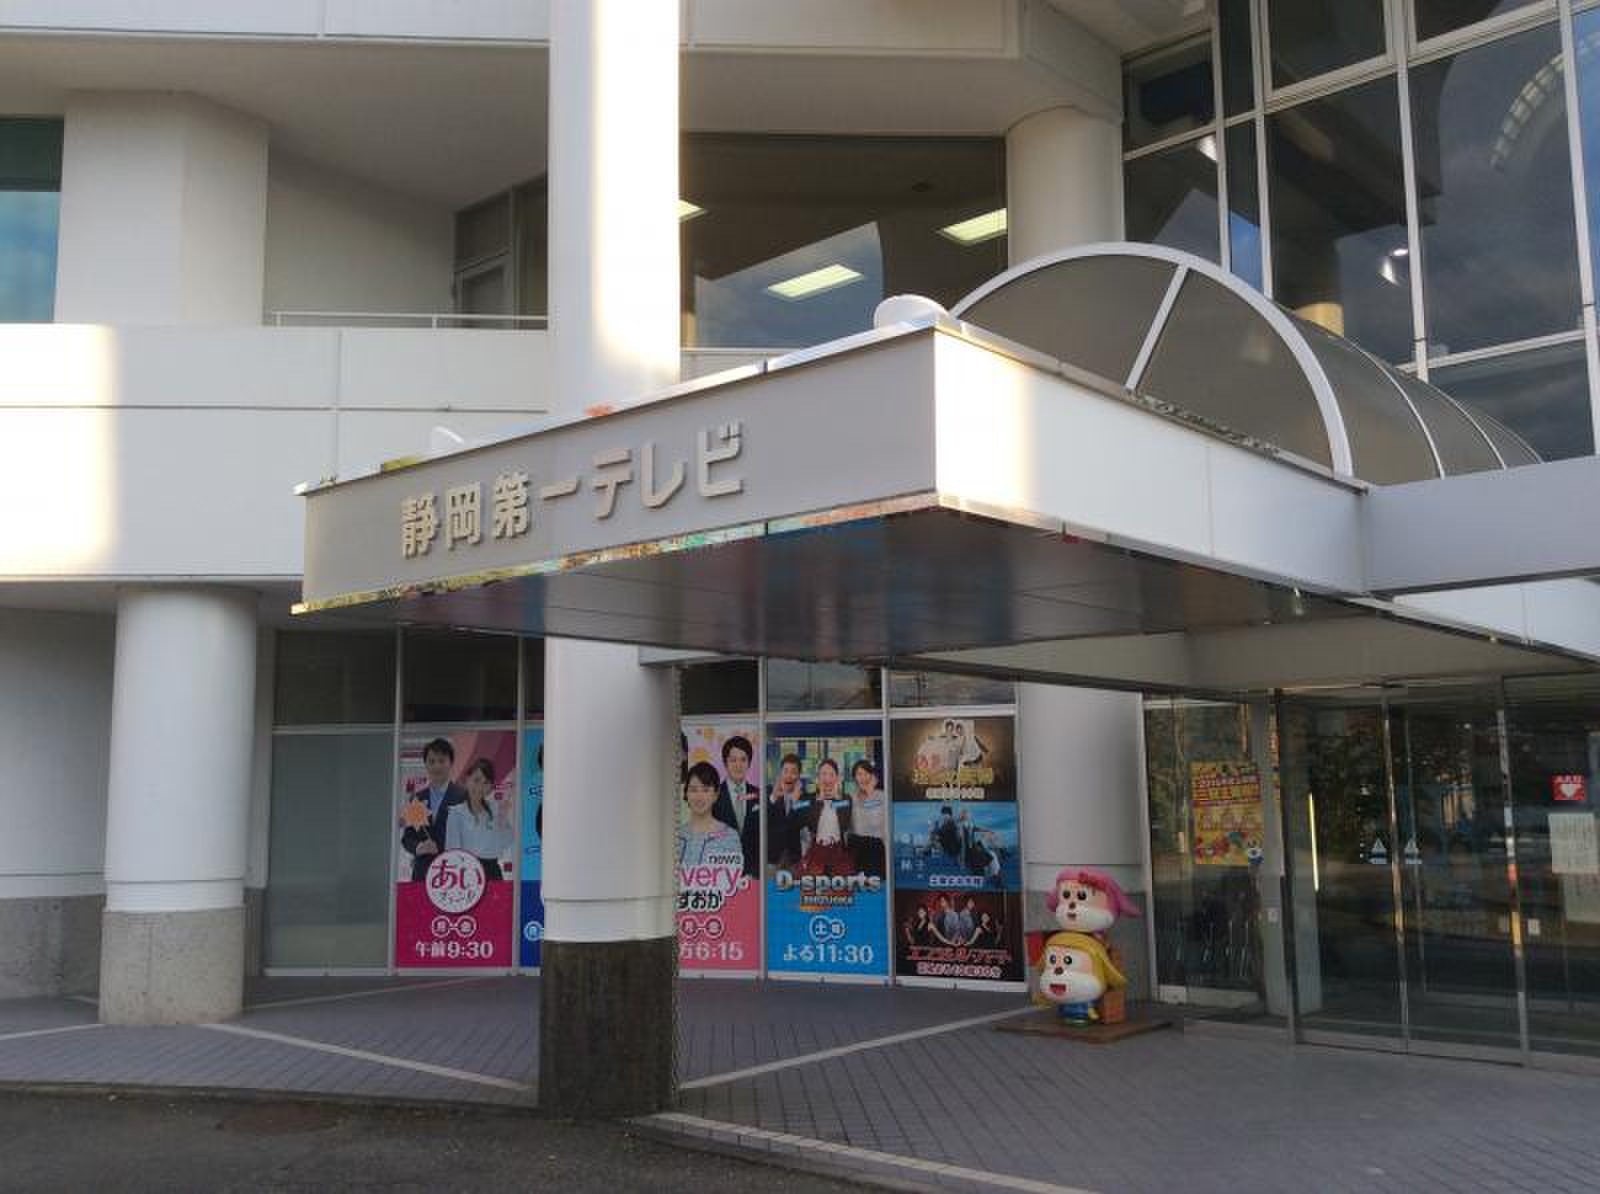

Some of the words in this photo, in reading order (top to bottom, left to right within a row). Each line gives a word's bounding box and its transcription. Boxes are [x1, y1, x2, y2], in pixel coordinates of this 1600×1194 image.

[401, 421, 744, 559] 静岡第一テレビ
[431, 859, 483, 891] あい
[681, 865, 748, 895] very.
[776, 869, 881, 895] D-sports
[784, 944, 873, 964] よる11:30
